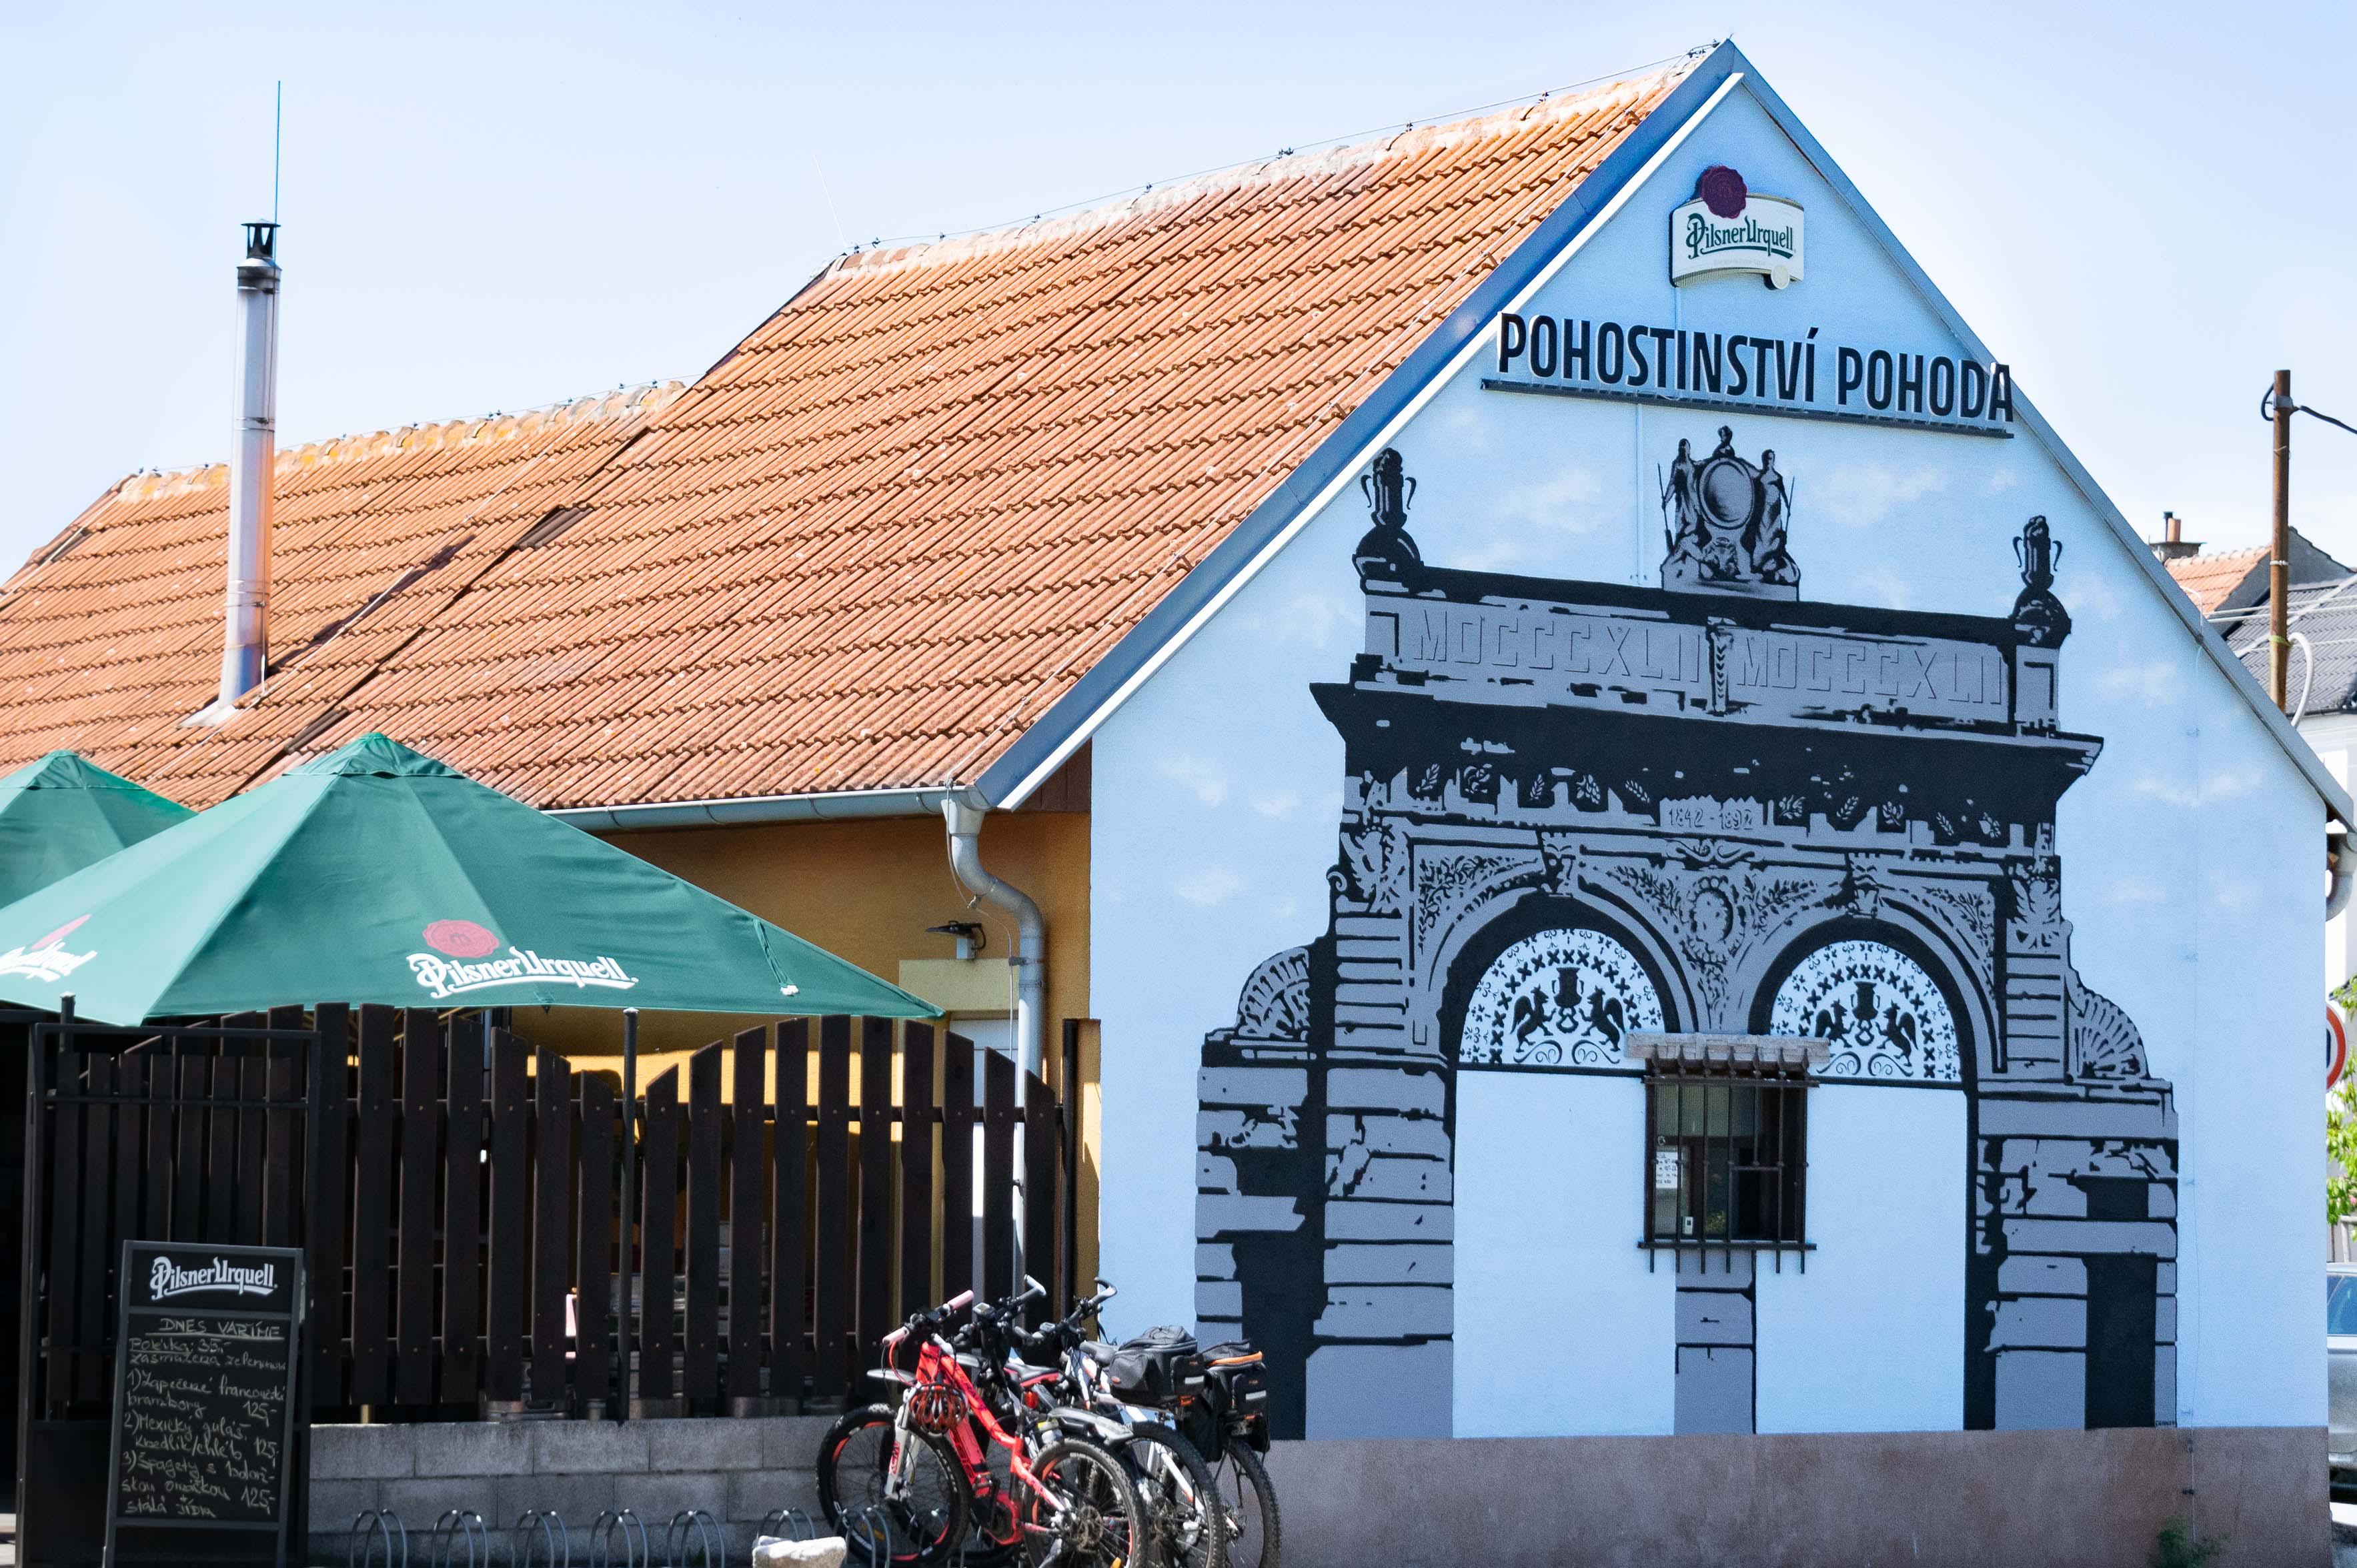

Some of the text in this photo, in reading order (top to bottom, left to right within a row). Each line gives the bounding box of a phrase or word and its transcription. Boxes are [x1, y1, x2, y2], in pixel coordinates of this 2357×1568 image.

[1686, 213, 1793, 259] Pilsner Urquell
[1498, 312, 2014, 422] POHOSTINSTVÍ POHODA
[1669, 808, 1705, 828] 1842
[406, 946, 629, 999] Pilsner Urquell
[150, 1256, 274, 1301] Pilsner Urquell
[159, 1318, 207, 1333] DNES
